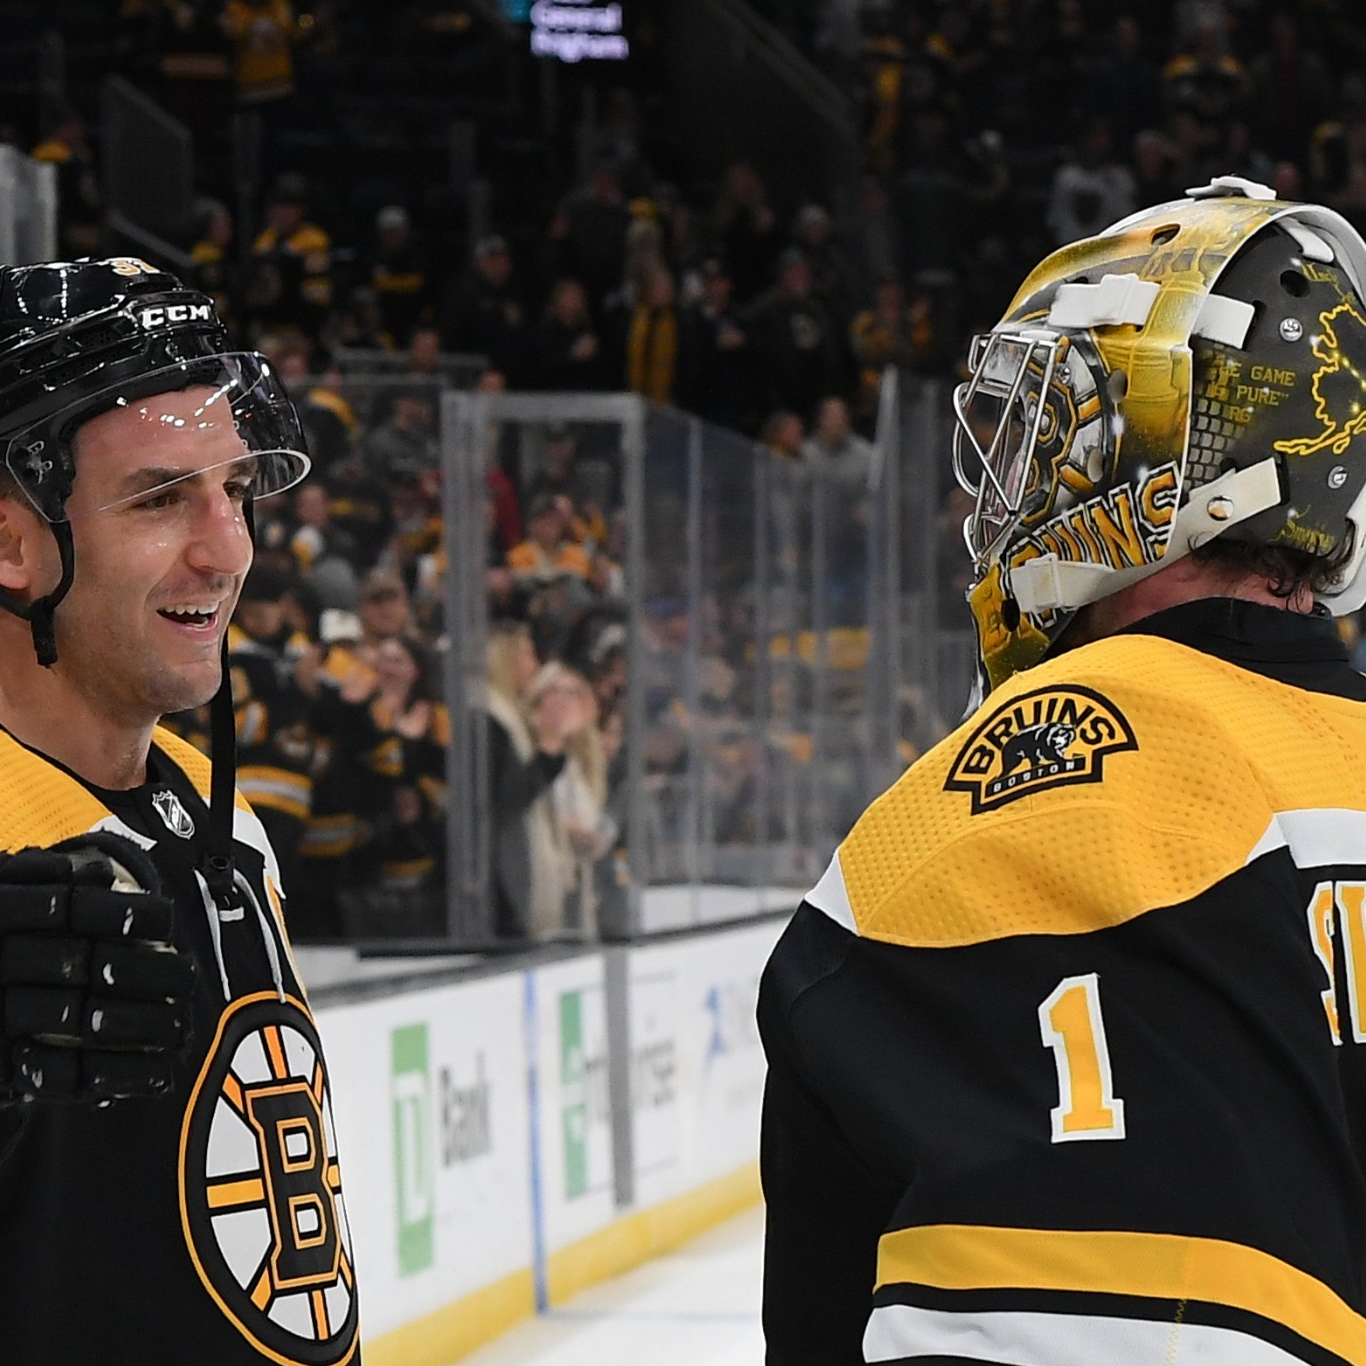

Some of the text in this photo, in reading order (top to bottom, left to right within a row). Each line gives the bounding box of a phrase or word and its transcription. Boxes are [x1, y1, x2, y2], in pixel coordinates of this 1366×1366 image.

[142, 304, 212, 332] CCM
[1250, 364, 1296, 387] GAME
[962, 698, 1116, 774] BRUINS
[992, 761, 1076, 793] BOSTON
[1037, 972, 1126, 1144] 1
